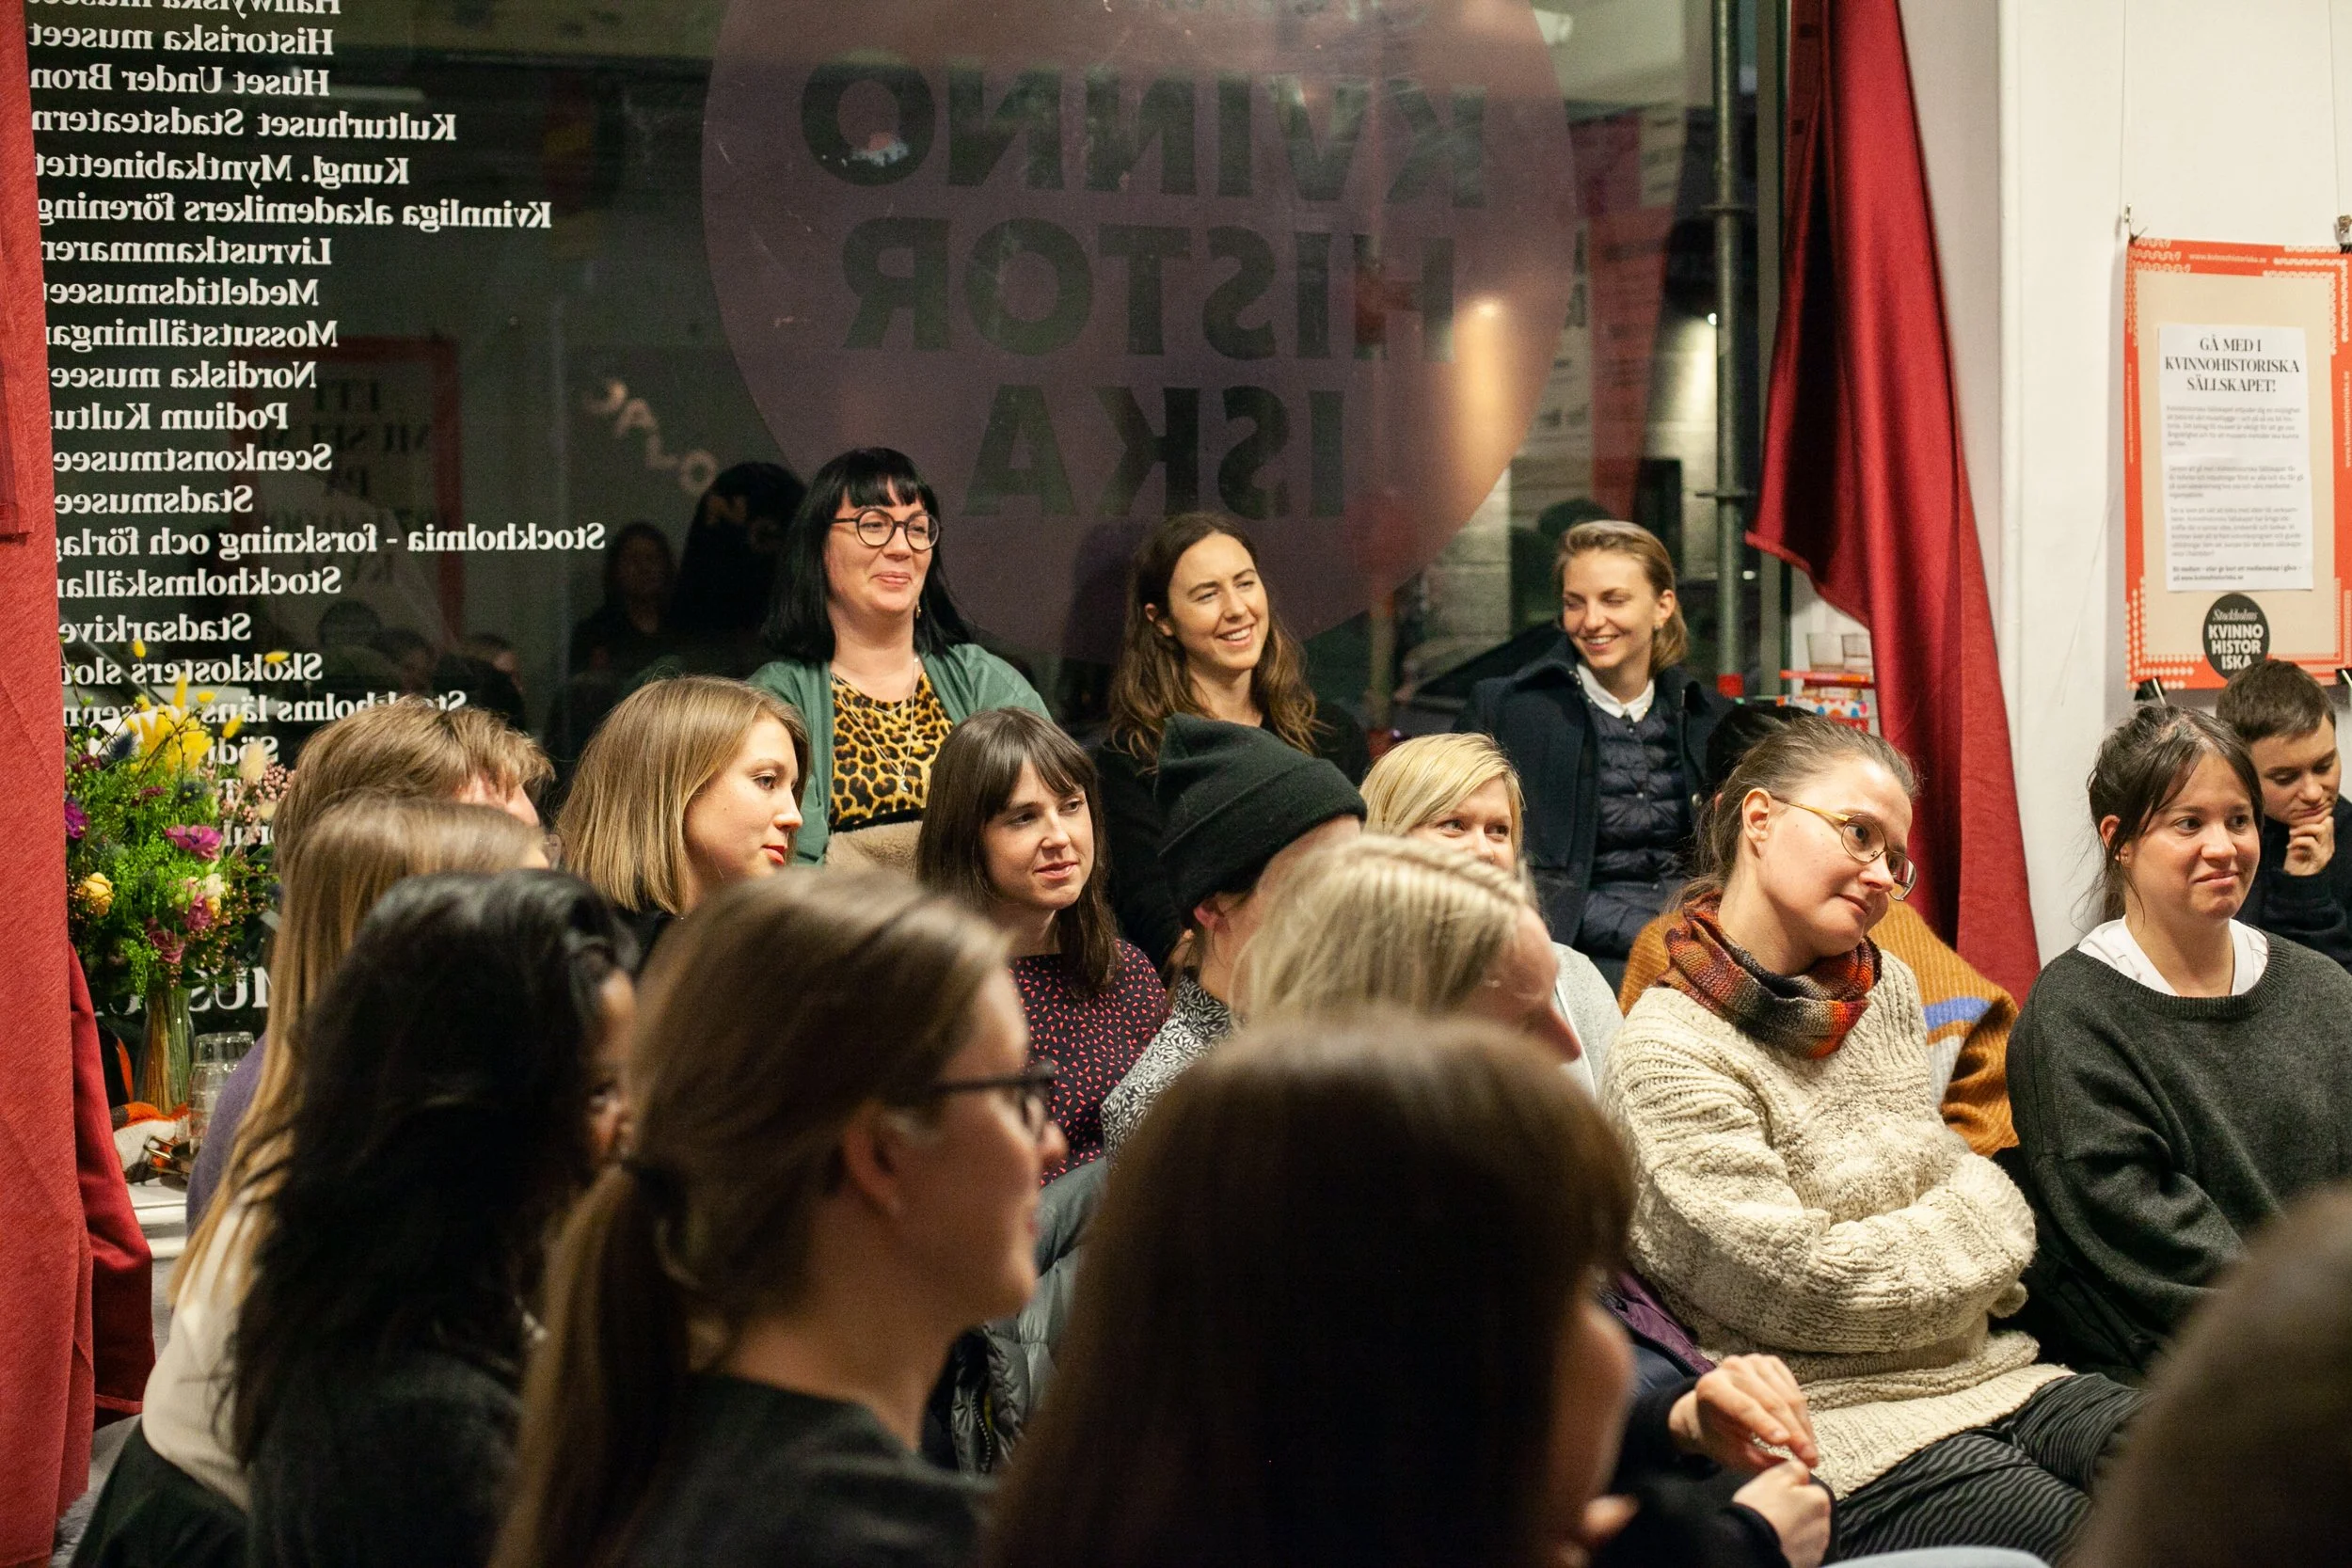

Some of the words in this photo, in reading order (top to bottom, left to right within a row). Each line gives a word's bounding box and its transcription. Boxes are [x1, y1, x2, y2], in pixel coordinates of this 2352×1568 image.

[2200, 335, 2218, 352] GÅ
[2222, 339, 2254, 352] MED
[2257, 339, 2262, 352] I
[2165, 356, 2300, 372] KVINNOHISTORISKA
[2186, 374, 2277, 392] SÄLLSKAPET!
[2208, 624, 2264, 639] KVINNO
[2212, 640, 2262, 655] HISTOR
[2221, 654, 2252, 670] ISKA
